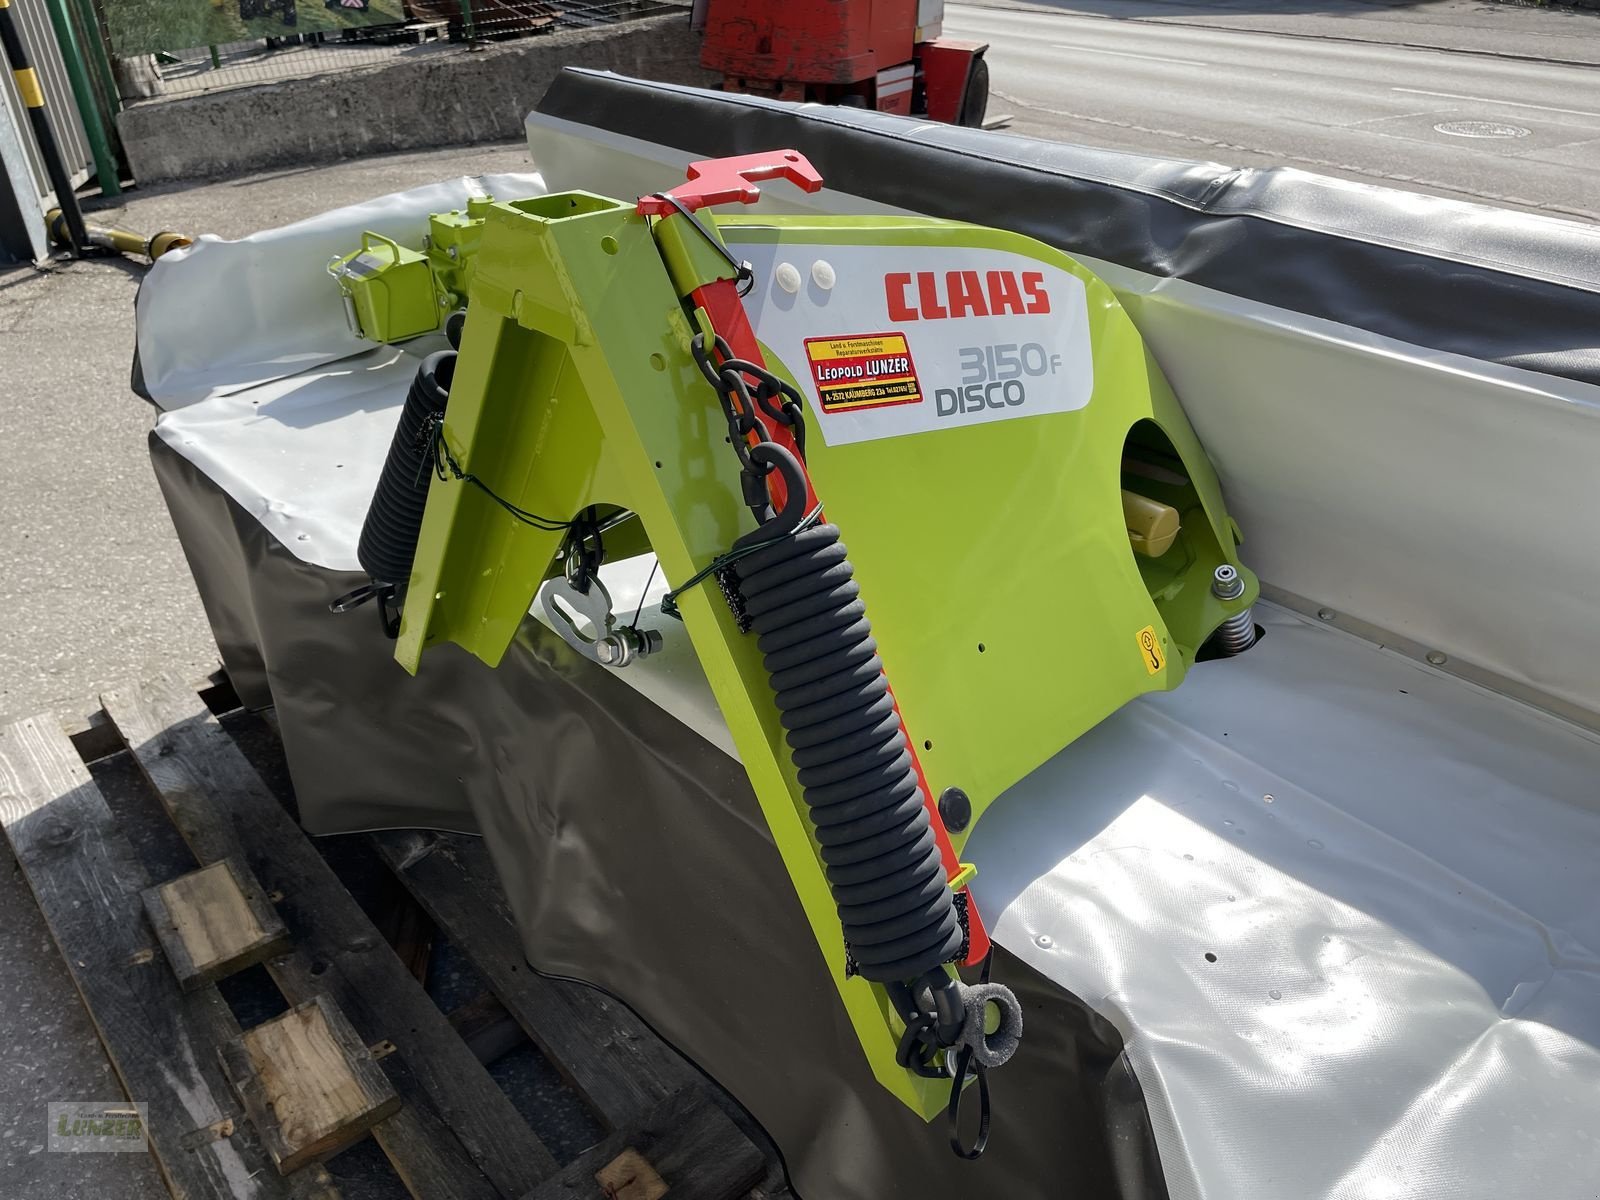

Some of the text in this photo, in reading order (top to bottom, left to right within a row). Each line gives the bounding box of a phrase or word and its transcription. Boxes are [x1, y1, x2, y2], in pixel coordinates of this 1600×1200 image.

[885, 271, 1050, 322] CLAAS
[866, 357, 909, 375] LUNZER
[935, 380, 1025, 417] DISCO
